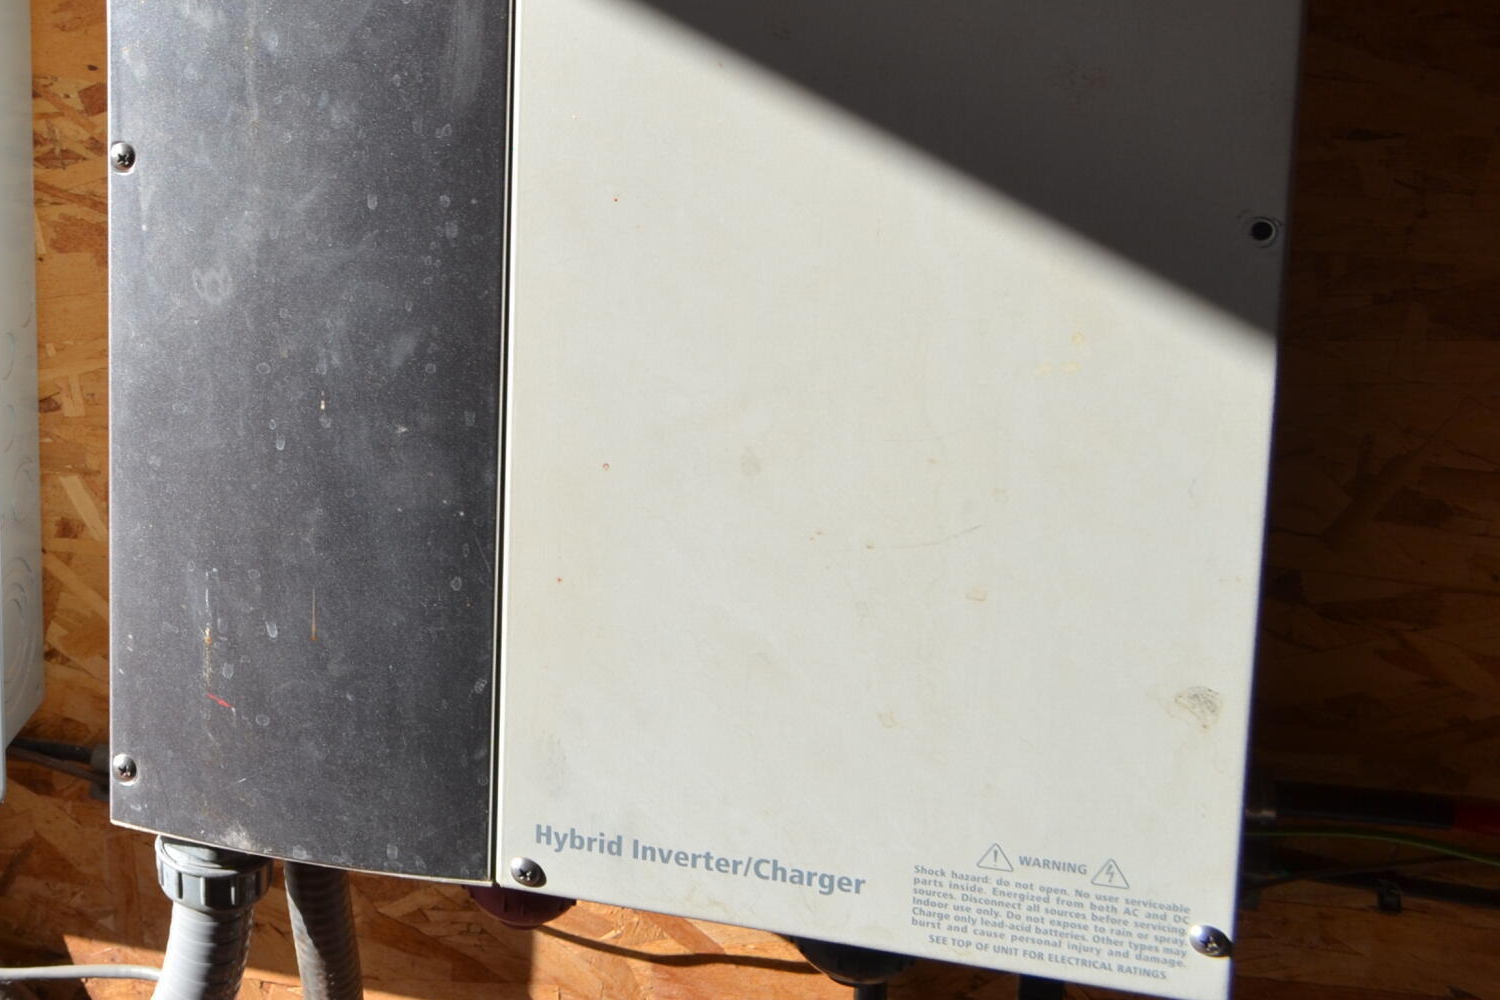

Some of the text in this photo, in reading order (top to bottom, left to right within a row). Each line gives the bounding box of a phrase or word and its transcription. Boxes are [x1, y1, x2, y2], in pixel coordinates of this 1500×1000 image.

[535, 823, 866, 894] Hybrid Inverter/Charger
[1018, 855, 1088, 875] WARNING
[913, 877, 1191, 925] parts inside. Energized from both AC and DC
[913, 887, 957, 900] sources.
[961, 893, 1021, 910] Disconnect
[1026, 904, 1040, 912] all
[1044, 907, 1086, 920] sources
[1091, 912, 1129, 926] before
[914, 864, 946, 877] Shock
[996, 877, 1010, 887] do
[1015, 881, 1034, 890] not
[1075, 889, 1090, 898] No
[1095, 893, 1119, 903] user
[1124, 898, 1191, 913] serviceable
[911, 907, 1187, 959] Charge only lead-acid batteries. Other types may
[911, 916, 1186, 968] burst and cause personal injury and damage.
[912, 896, 949, 909] Indoor
[953, 904, 972, 913] use
[976, 908, 1001, 919] only.
[1006, 911, 1021, 920] Do
[1026, 915, 1045, 924] not
[1049, 920, 1089, 931] expose
[1094, 925, 1106, 934] to
[1110, 928, 1133, 938] rain
[1137, 931, 1149, 940] or
[928, 934, 1168, 980] SEE TOP OF UNIT FOR ELECTRICAL RATINGS
